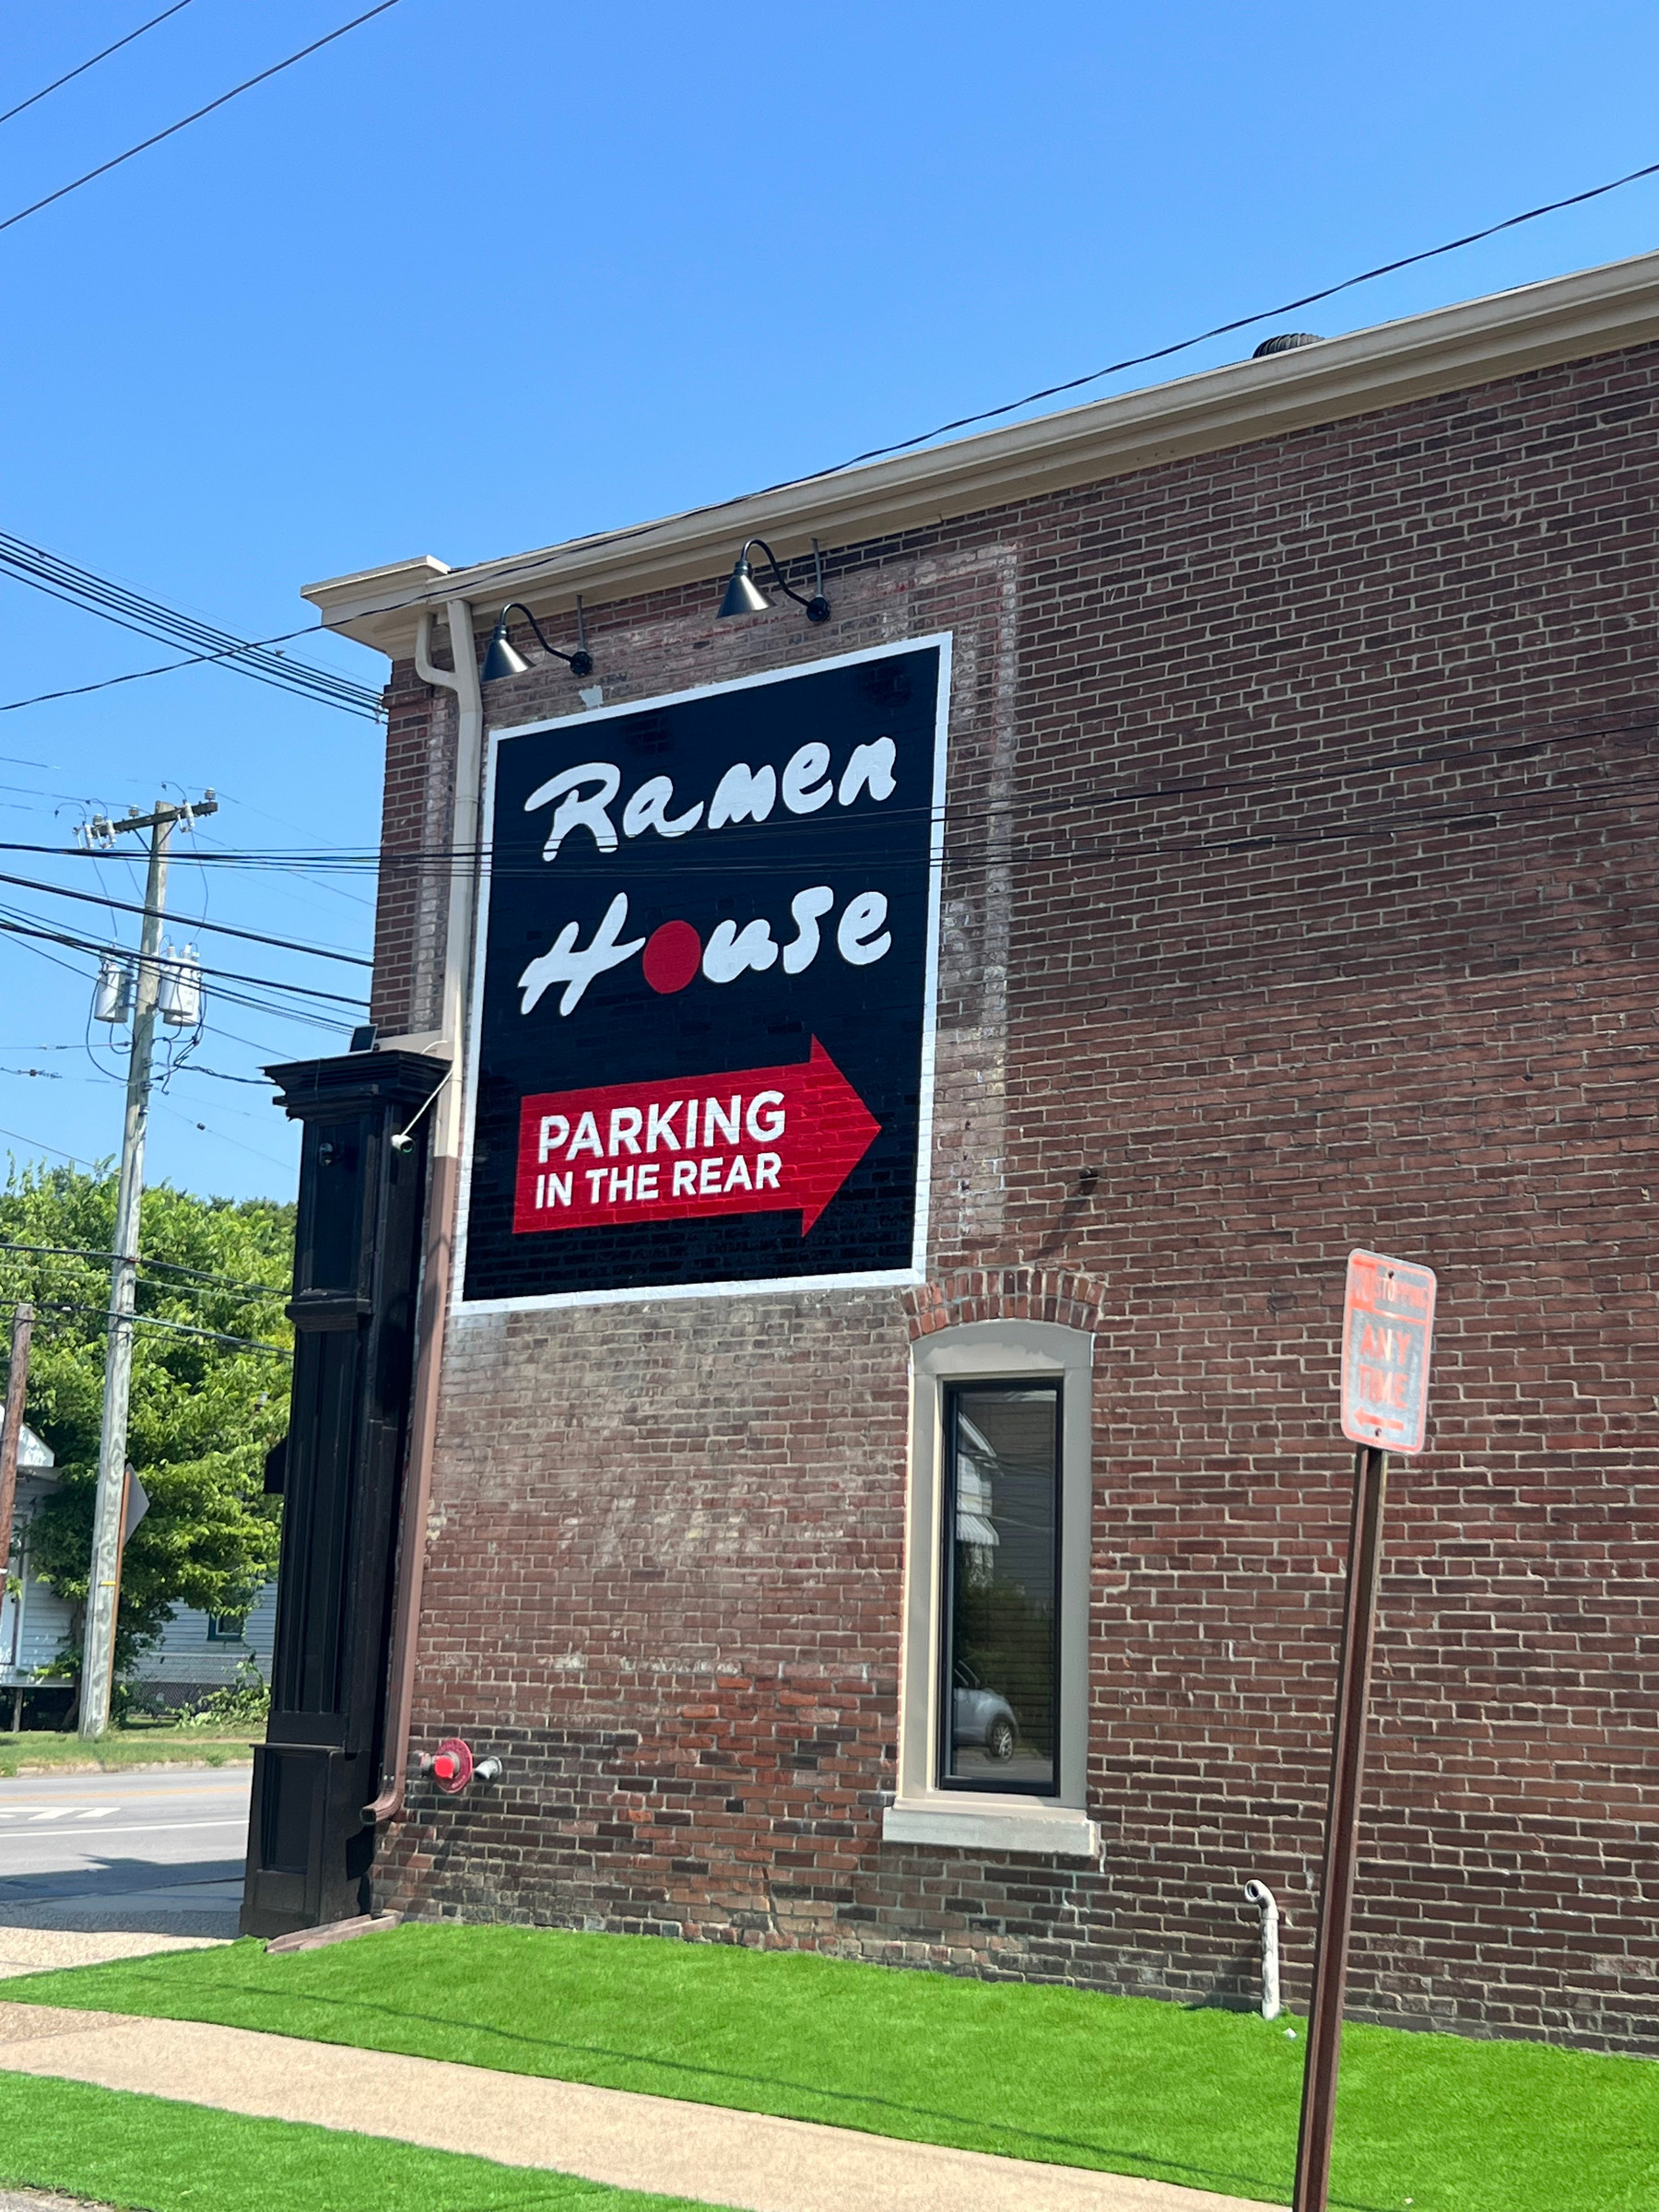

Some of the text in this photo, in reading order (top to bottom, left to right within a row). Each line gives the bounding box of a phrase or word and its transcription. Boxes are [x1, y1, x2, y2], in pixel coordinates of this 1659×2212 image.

[524, 736, 897, 862] Ramen
[518, 886, 892, 1016] House
[538, 1090, 785, 1164] PARKING
[535, 1152, 782, 1209] IN THE REAR
[1374, 1275, 1429, 1309] STOPP
[1359, 1324, 1411, 1366] ANY
[1358, 1364, 1408, 1409] TIME
